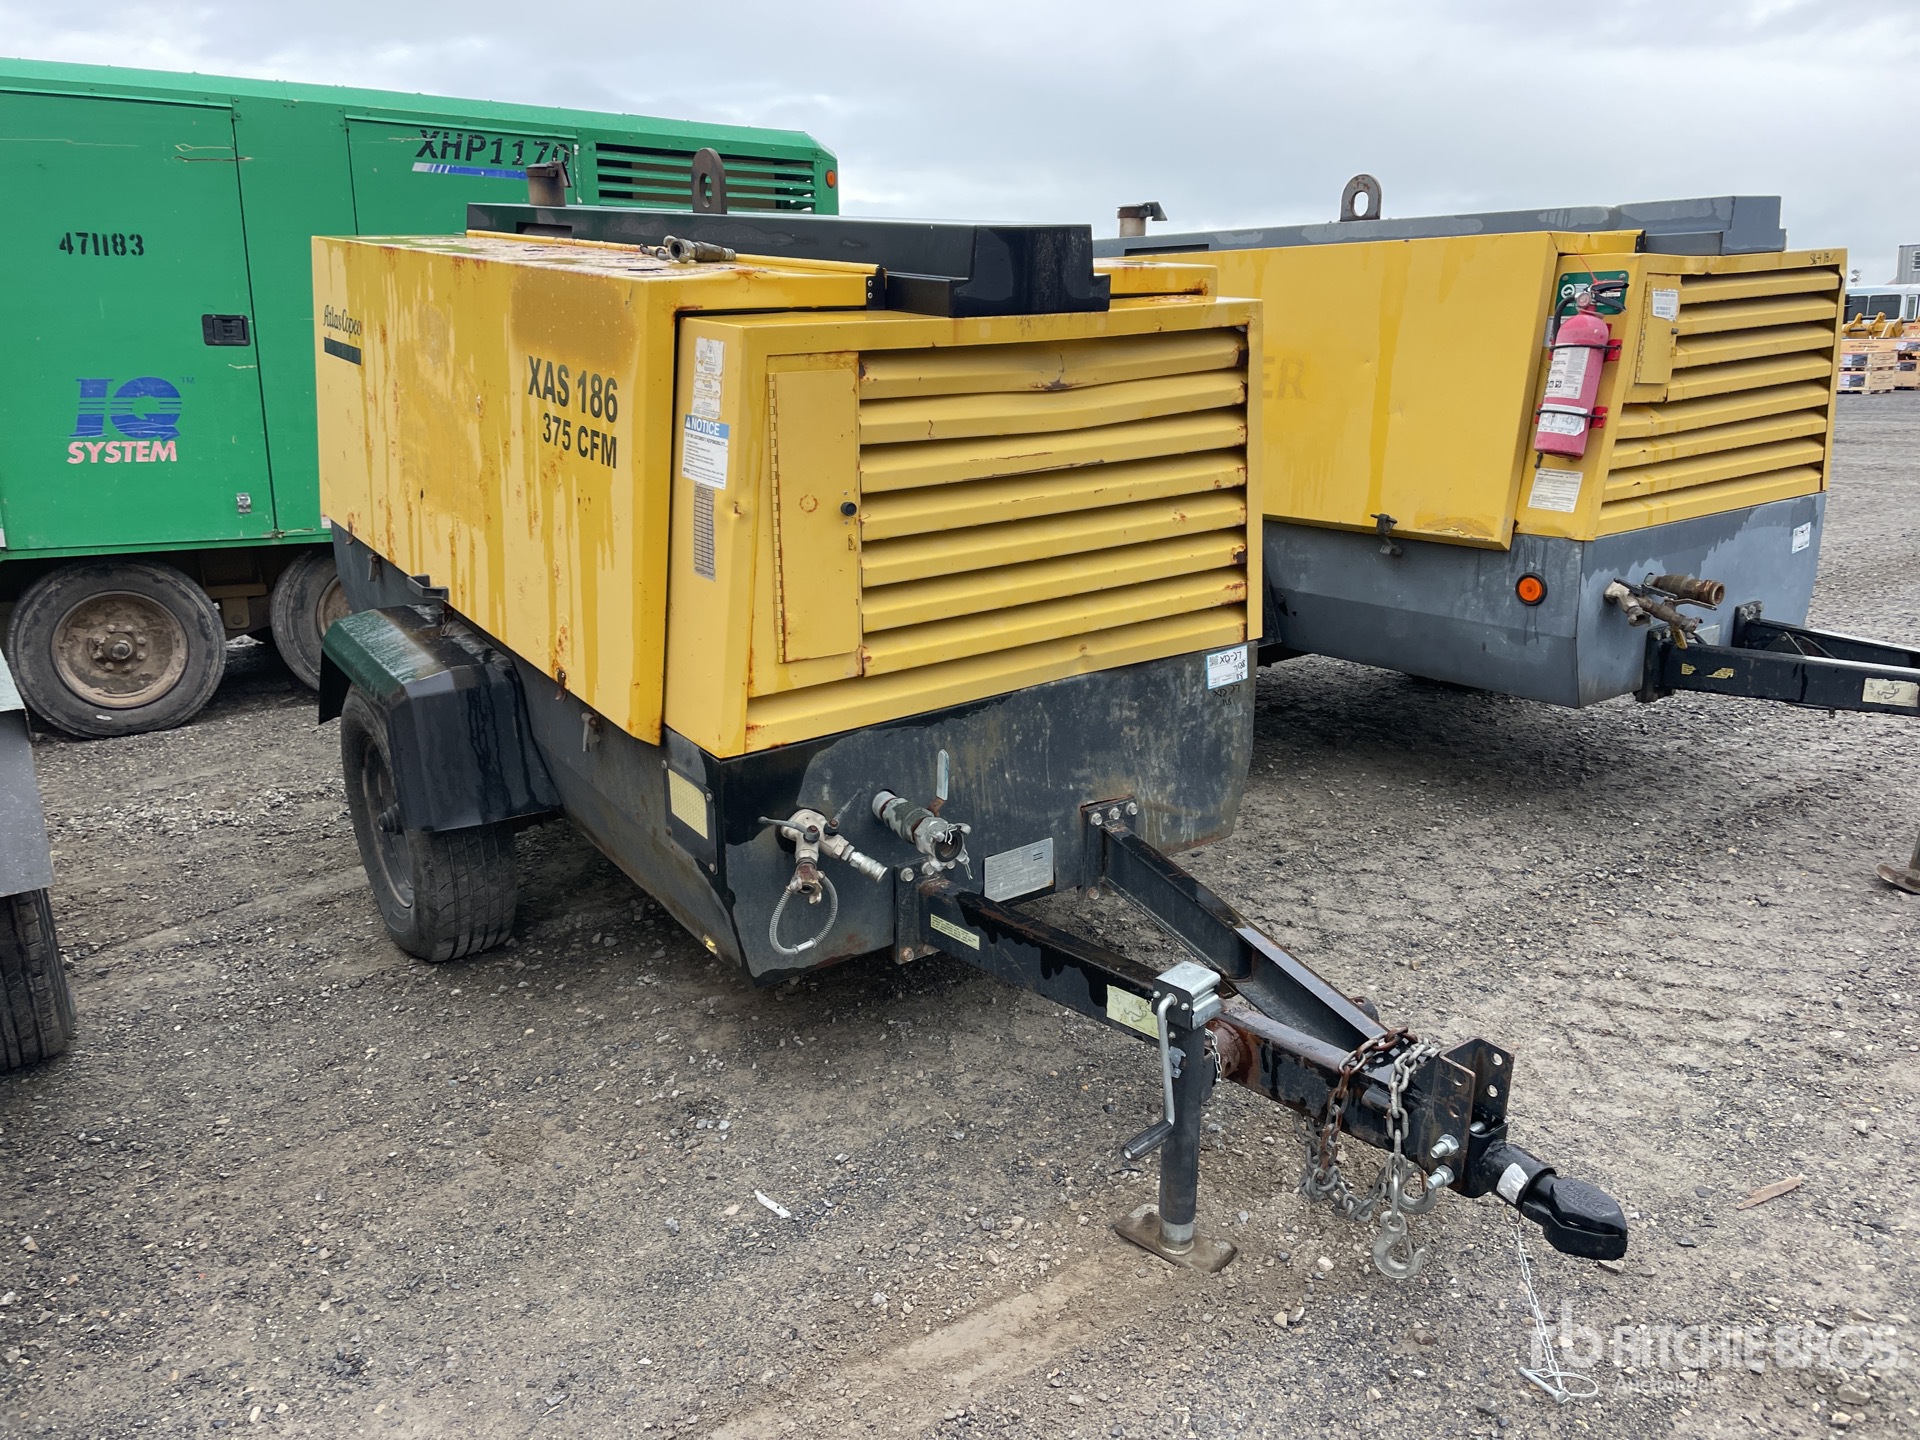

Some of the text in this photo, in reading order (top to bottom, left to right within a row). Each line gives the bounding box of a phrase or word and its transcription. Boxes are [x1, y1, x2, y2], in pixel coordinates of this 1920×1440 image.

[415, 129, 570, 168] XHP1170
[59, 232, 144, 256] 471183
[67, 376, 182, 441] IQ
[528, 355, 618, 423] XAS 186
[542, 412, 617, 469] 375 CFM
[691, 416, 720, 436] NOTICE
[67, 440, 178, 464] SYSTEM
